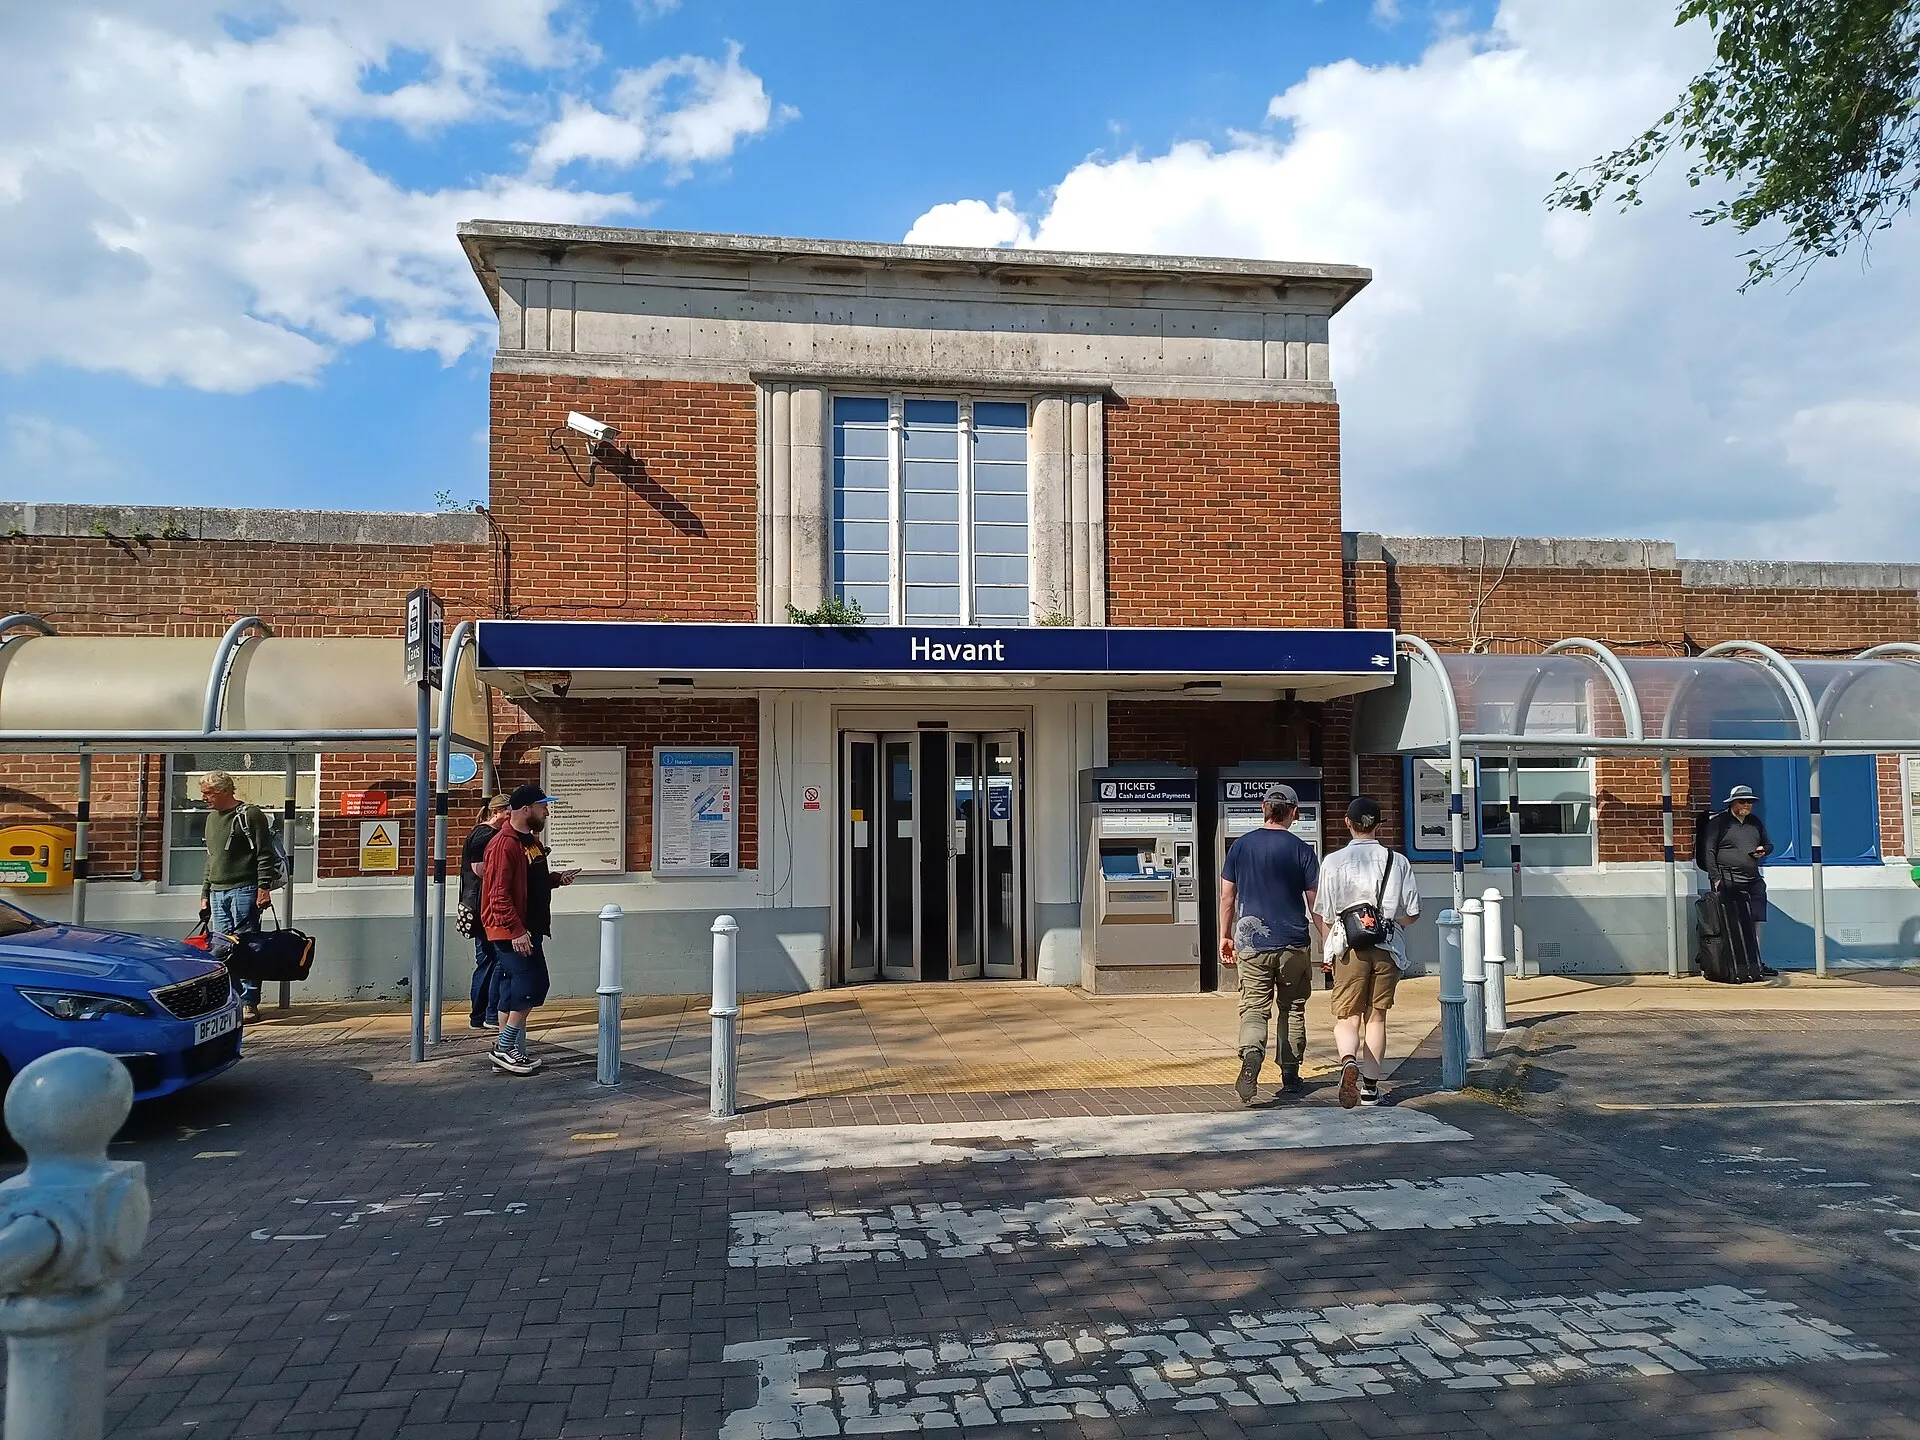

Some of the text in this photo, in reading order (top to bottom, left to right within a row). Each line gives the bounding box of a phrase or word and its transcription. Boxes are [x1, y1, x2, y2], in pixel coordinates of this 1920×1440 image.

[408, 644, 420, 662] Taxis
[911, 636, 1005, 661] Havant
[1118, 782, 1156, 790] TICKETS
[200, 1018, 218, 1039] BF21
